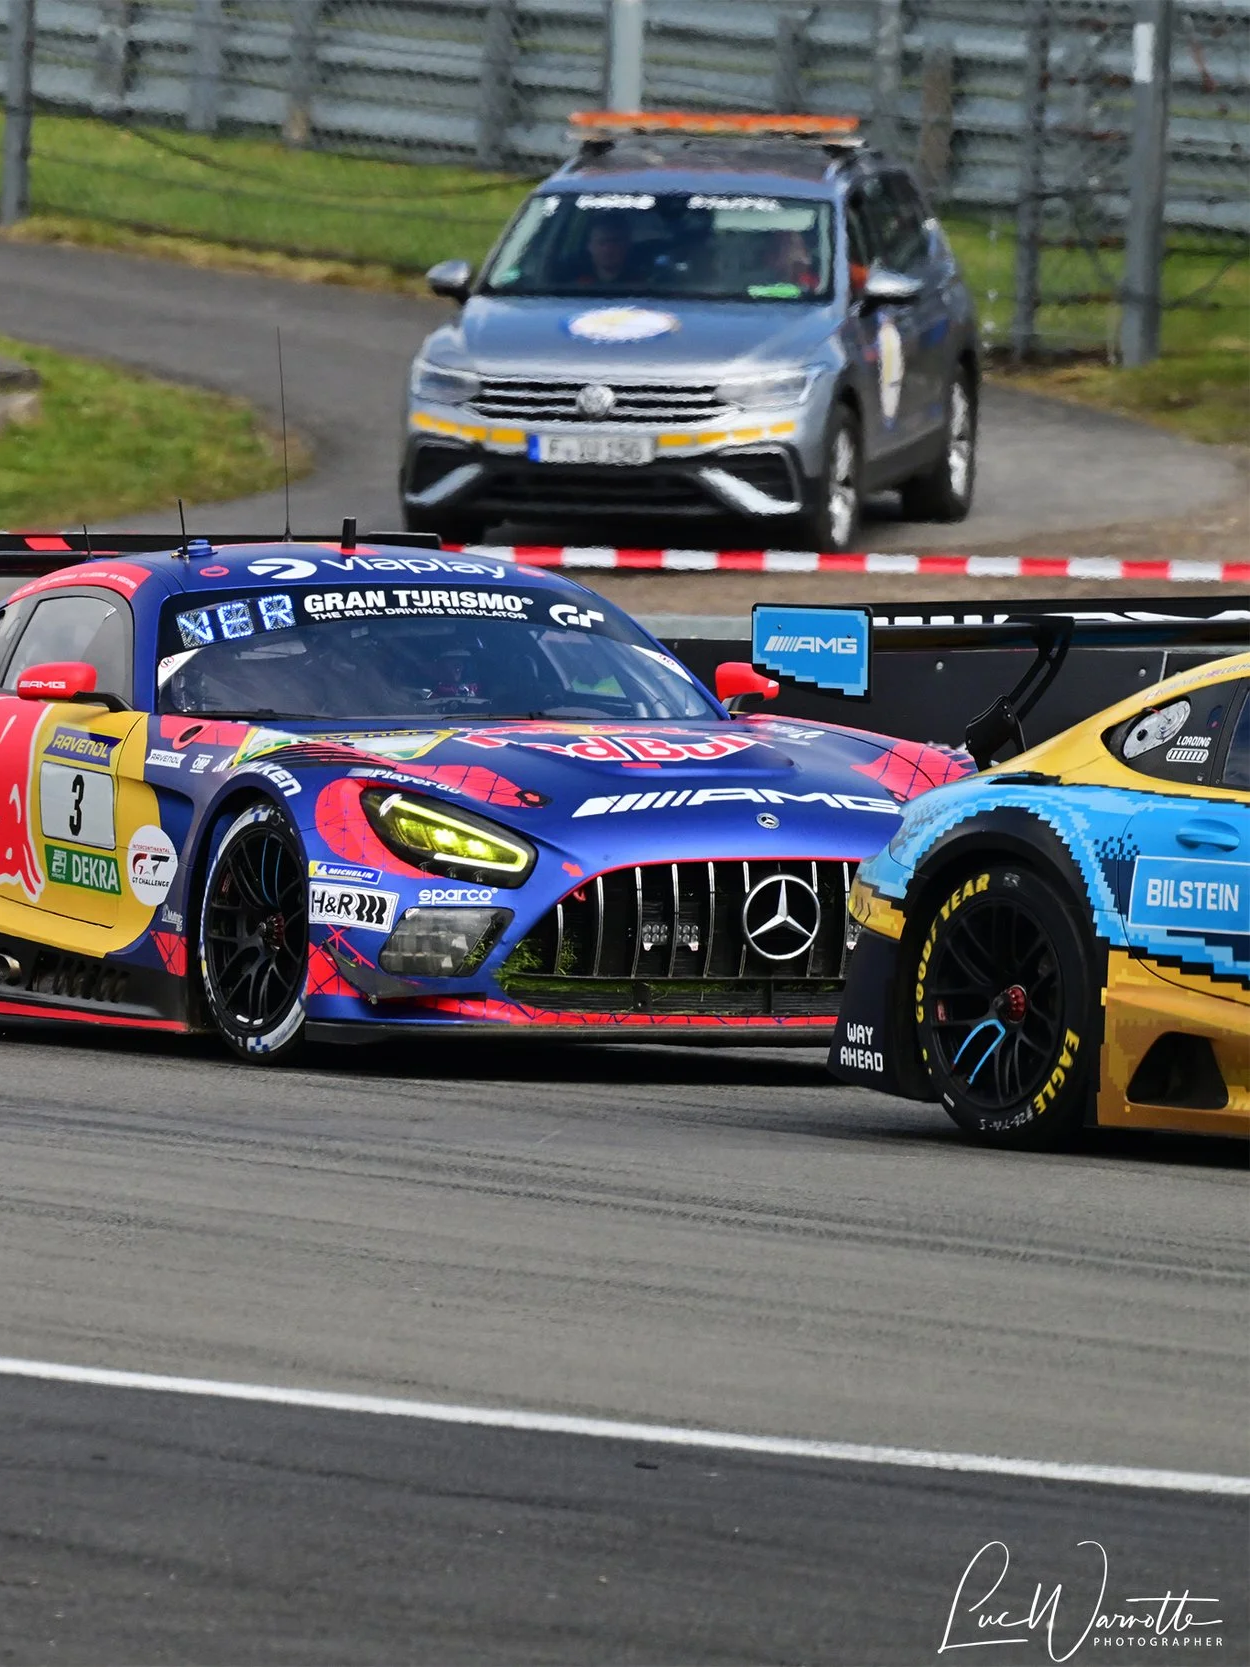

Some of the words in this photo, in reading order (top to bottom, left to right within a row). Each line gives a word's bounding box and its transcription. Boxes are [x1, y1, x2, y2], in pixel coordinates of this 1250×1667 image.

[304, 590, 375, 614] GRAN
[392, 590, 524, 612] TURISMO
[310, 611, 342, 622] THE
[344, 608, 383, 618] REAL
[385, 606, 445, 616] DRIVING
[447, 607, 528, 620] SIMULATOR
[793, 636, 858, 654] AMG
[29, 681, 66, 689] AMG
[53, 734, 109, 758] RAVENOL
[1176, 735, 1212, 748] LOADING
[150, 752, 180, 765] RAVENOL
[228, 760, 302, 797] LKEN
[68, 774, 85, 837] 3
[686, 788, 901, 815] AMG
[71, 853, 119, 892] DEKRA
[138, 878, 170, 888] CHALLENGE
[328, 868, 374, 880] MICHELIN
[310, 888, 353, 918] H&R
[418, 888, 492, 905] sparco
[1146, 878, 1239, 912] BILSTEIN
[846, 1021, 874, 1046] WAY
[840, 1045, 884, 1073] AHEAD
[1033, 1027, 1081, 1115] EAGLE
